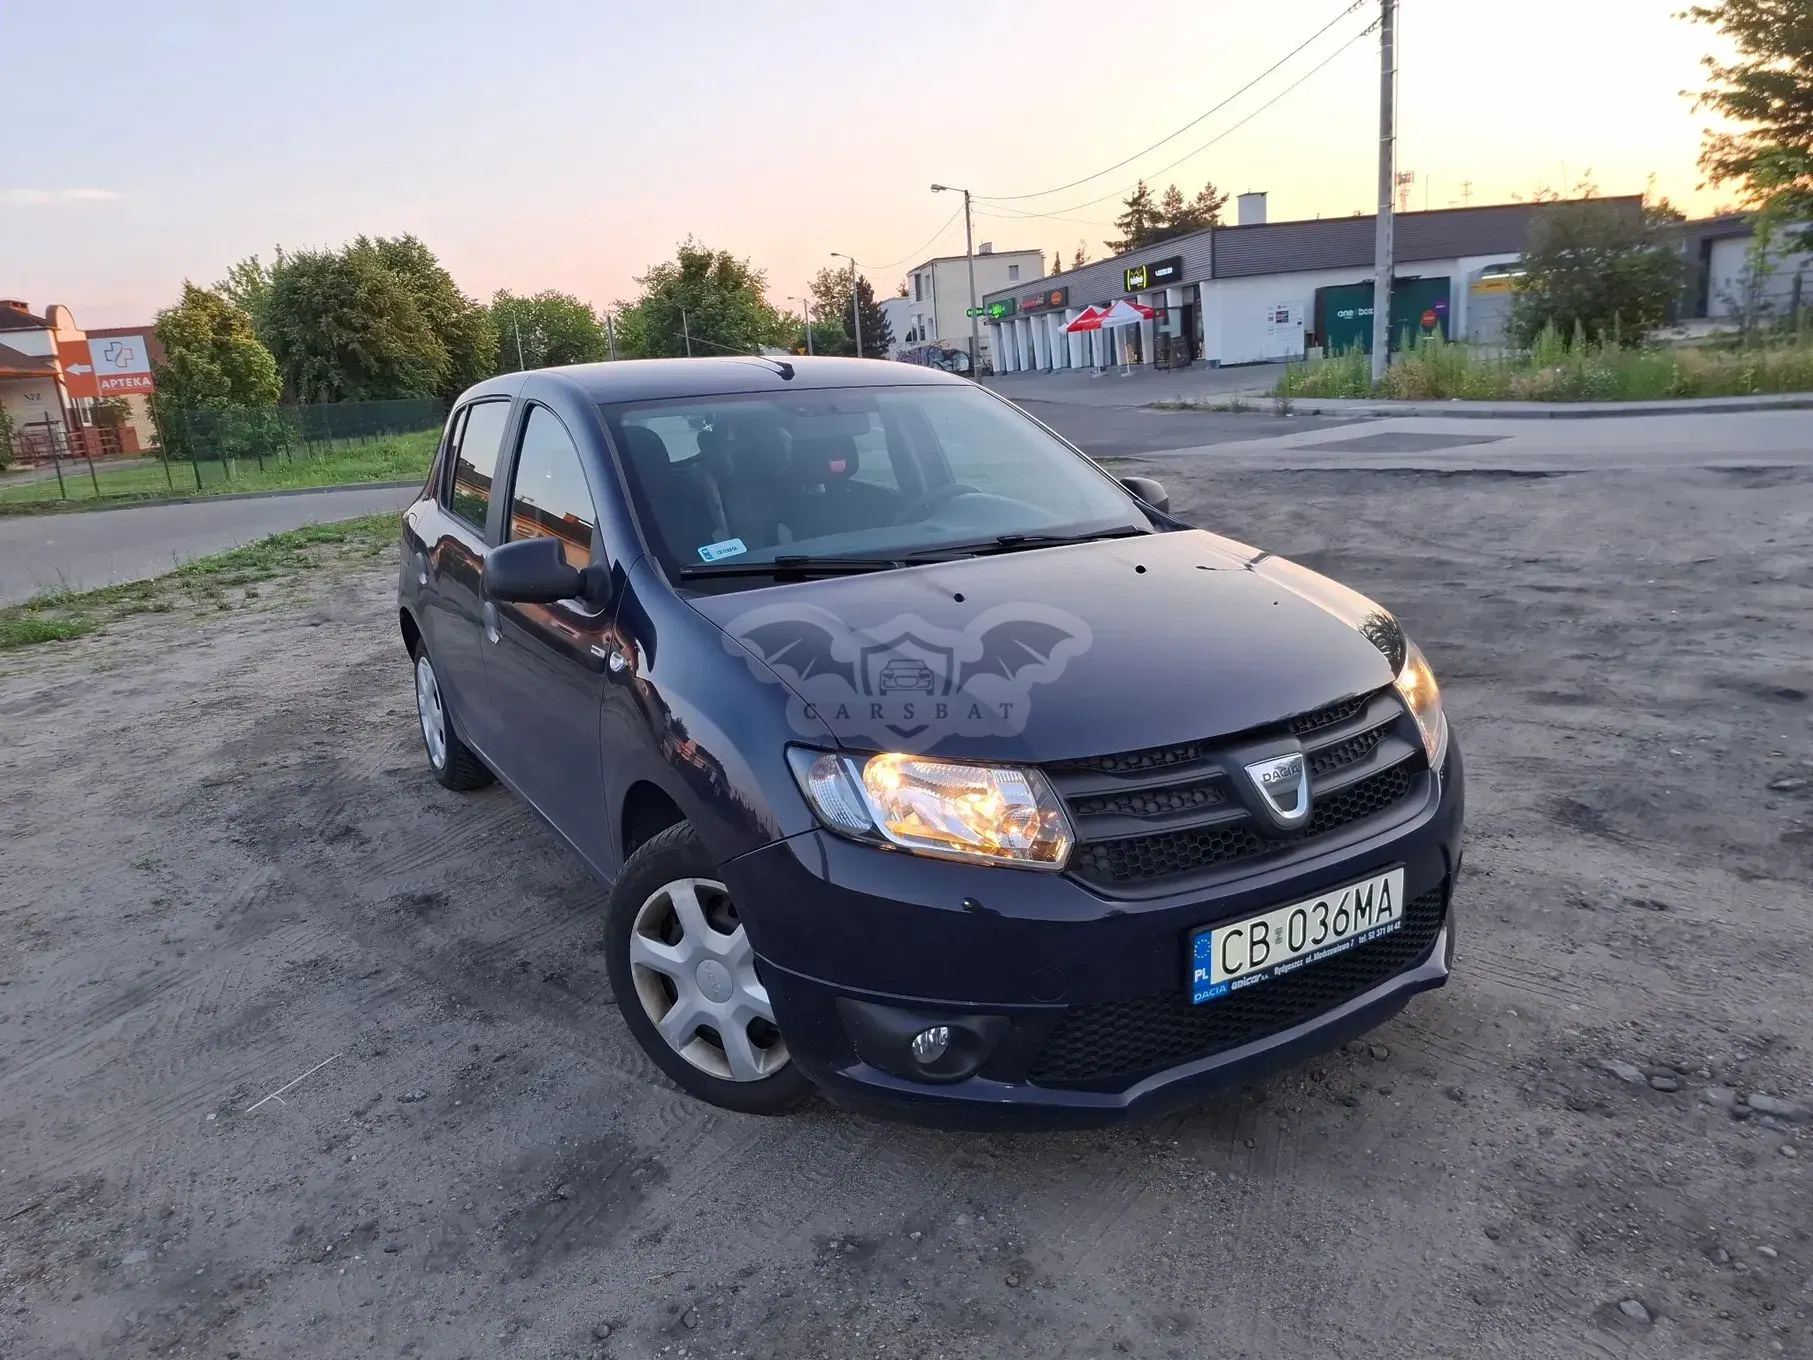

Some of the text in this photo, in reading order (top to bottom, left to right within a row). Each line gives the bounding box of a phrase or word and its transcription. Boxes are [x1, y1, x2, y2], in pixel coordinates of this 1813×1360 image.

[102, 377, 151, 388] APTEKA
[1262, 765, 1300, 783] DACIA
[1221, 878, 1394, 975] CB 036MA
[1194, 969, 1208, 982] PL
[1194, 985, 1227, 1001] DACIA
[1274, 959, 1303, 976] Bydgoszcz
